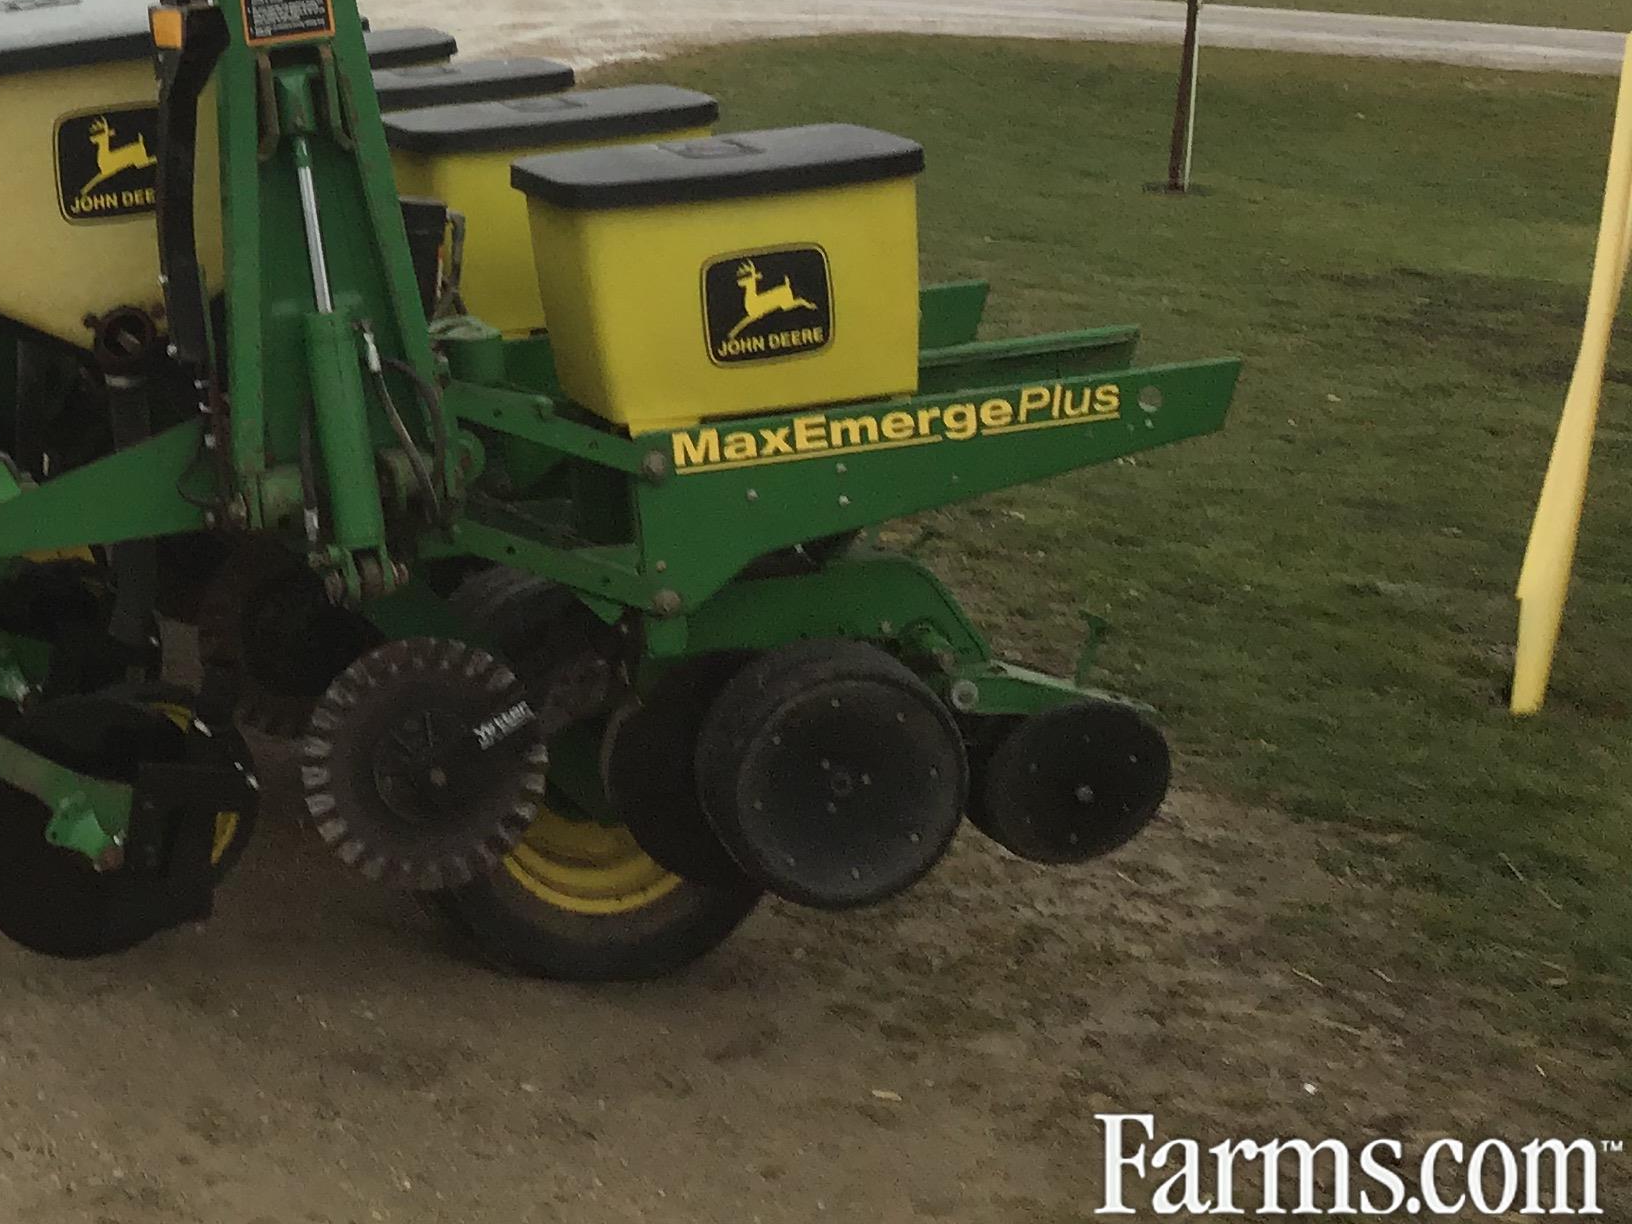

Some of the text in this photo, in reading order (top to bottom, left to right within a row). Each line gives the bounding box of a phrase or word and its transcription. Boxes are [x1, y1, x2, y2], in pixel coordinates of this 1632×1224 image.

[70, 187, 157, 214] JOHN DEE
[718, 326, 824, 357] JOHN DEERE
